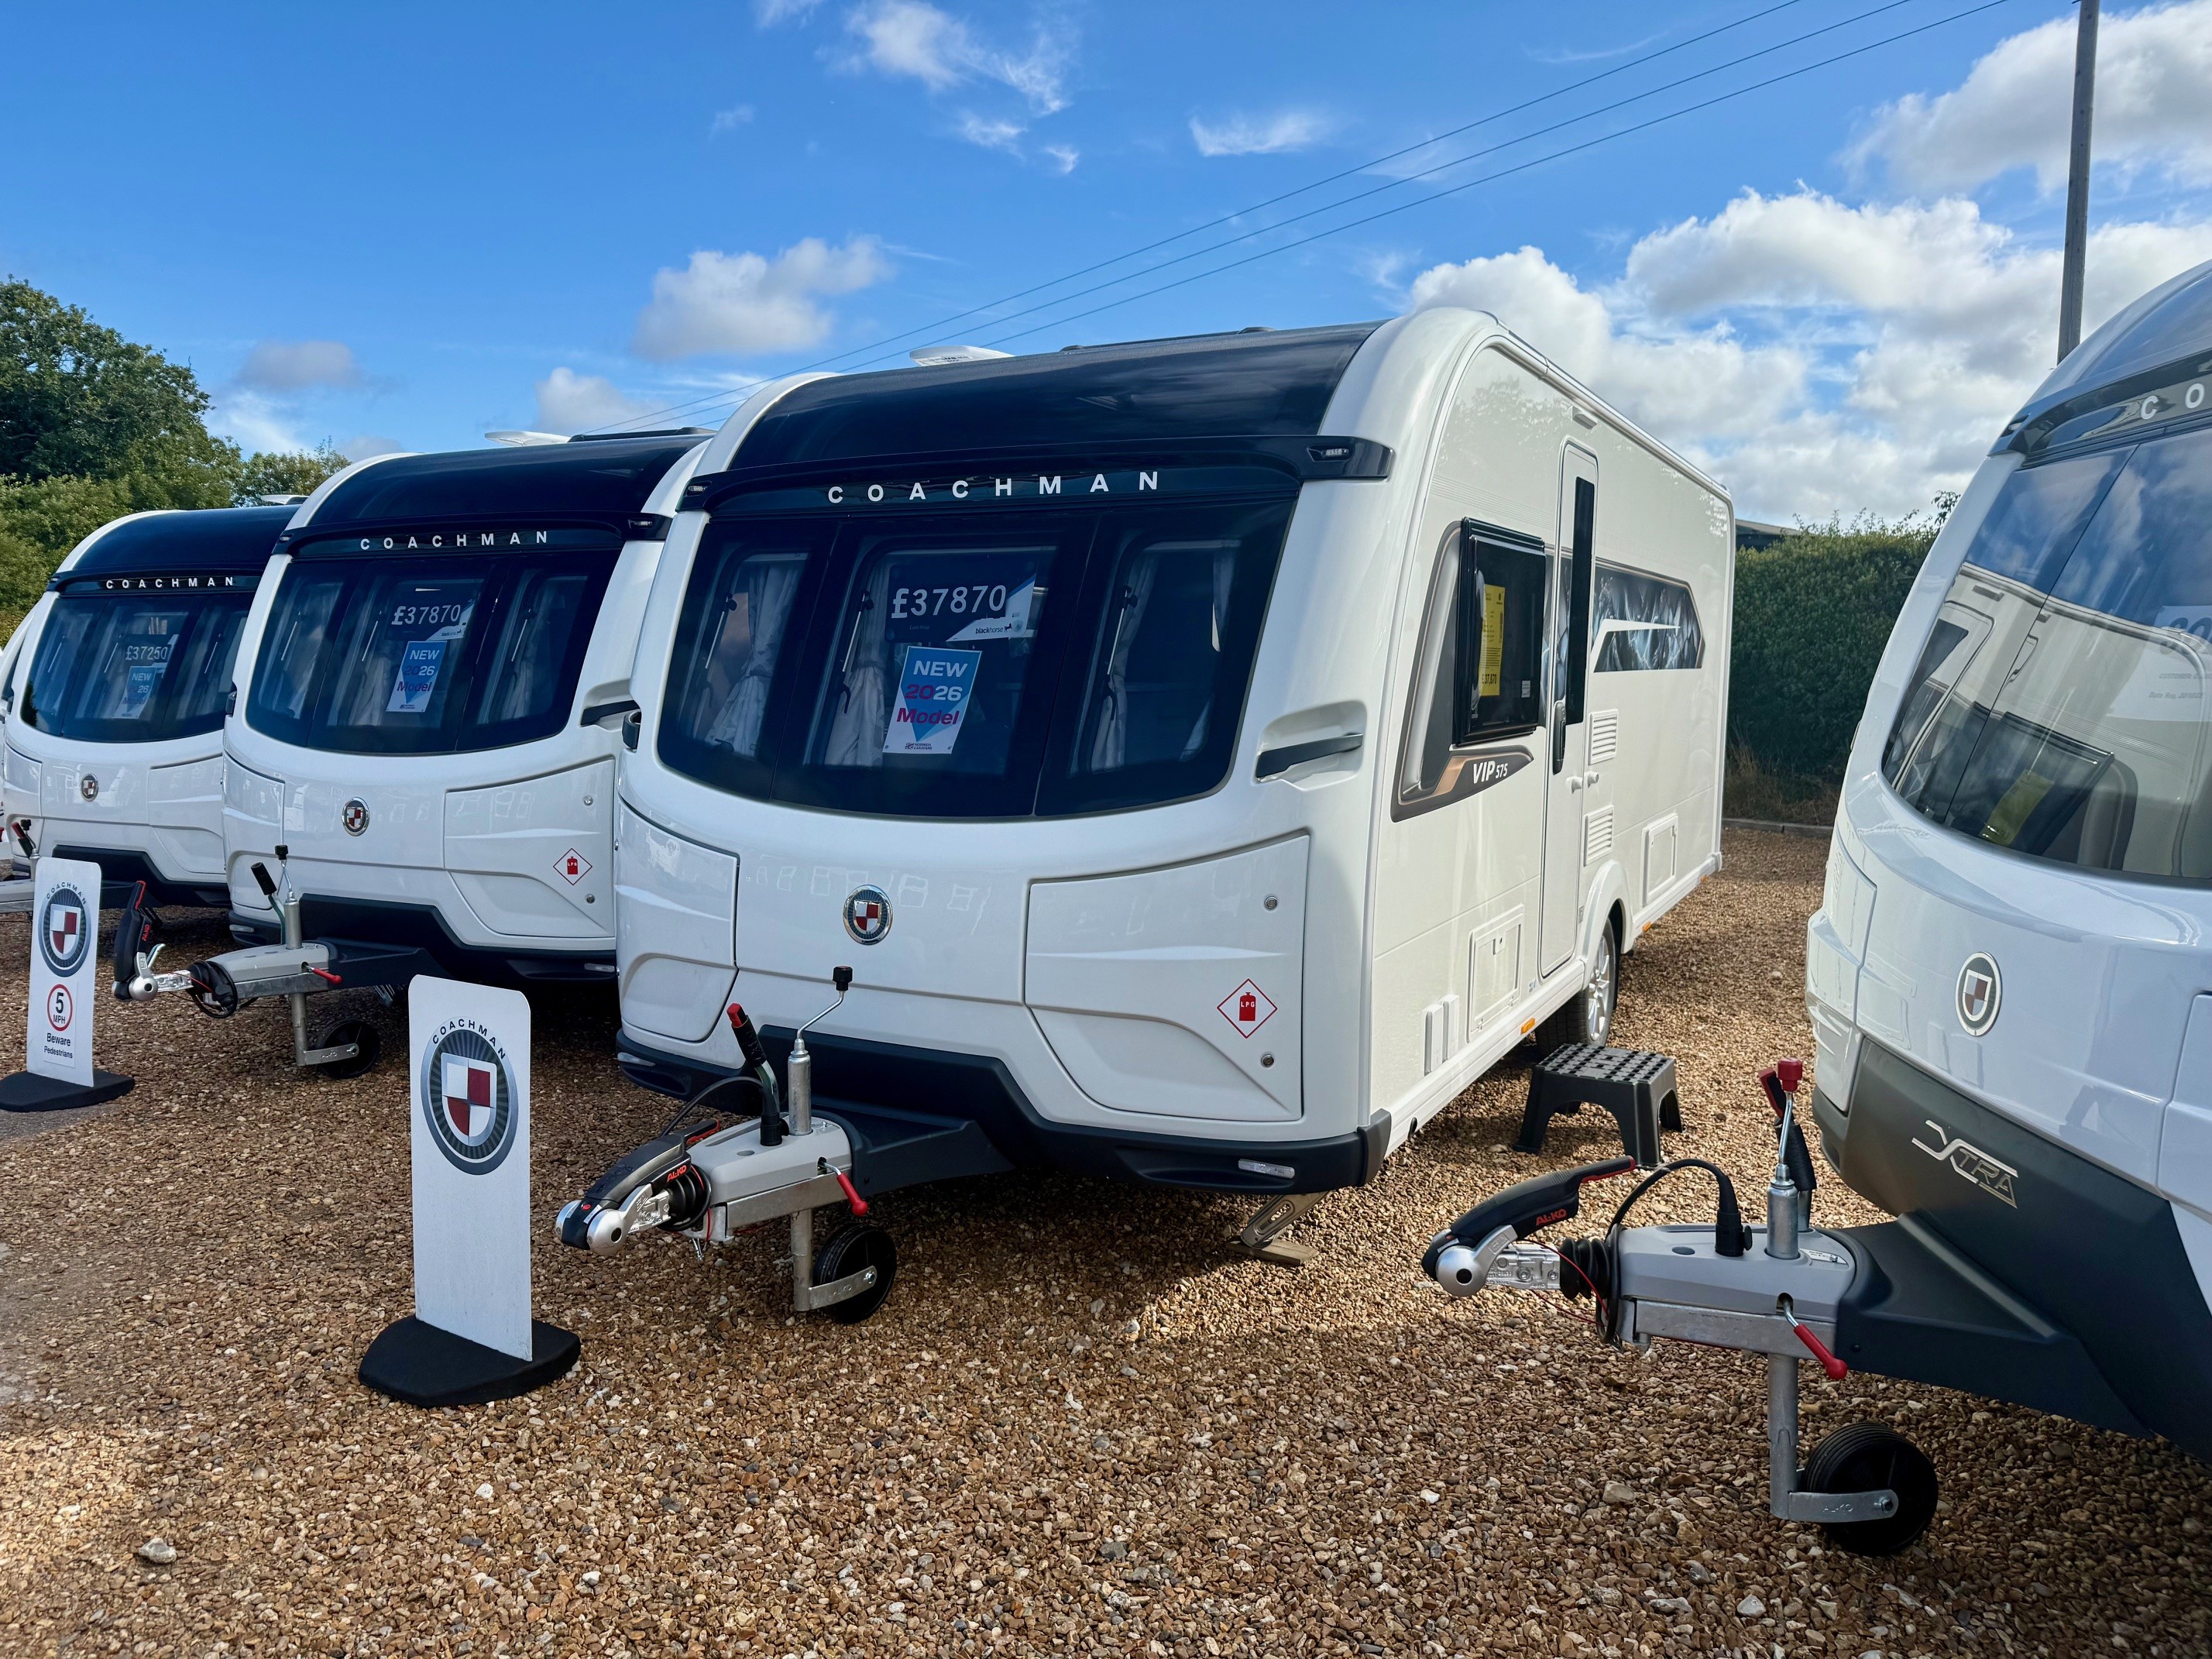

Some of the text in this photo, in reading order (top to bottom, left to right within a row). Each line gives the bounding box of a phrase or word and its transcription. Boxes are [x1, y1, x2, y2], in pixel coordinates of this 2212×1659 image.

[827, 471, 1159, 504] COACHMAN
[359, 531, 548, 551] COACHMAN
[105, 576, 234, 589] COACHMAN
[891, 585, 1007, 619] £37870
[391, 604, 462, 626] £37870
[125, 645, 169, 661] £37250
[409, 650, 440, 660] NEW
[131, 672, 152, 682] NEW
[404, 665, 436, 676] 2026
[912, 660, 968, 678] NEW
[397, 681, 433, 692] Model
[904, 684, 963, 702] 2026
[896, 707, 960, 725] Model
[1473, 761, 1509, 784] VIP 575
[46, 881, 87, 905] COACHMAN
[55, 991, 64, 1014] 5
[53, 1015, 66, 1025] MPH
[46, 1032, 71, 1047] Beware
[432, 1018, 506, 1060] COACHMAN
[43, 1046, 73, 1059] Pedestrians
